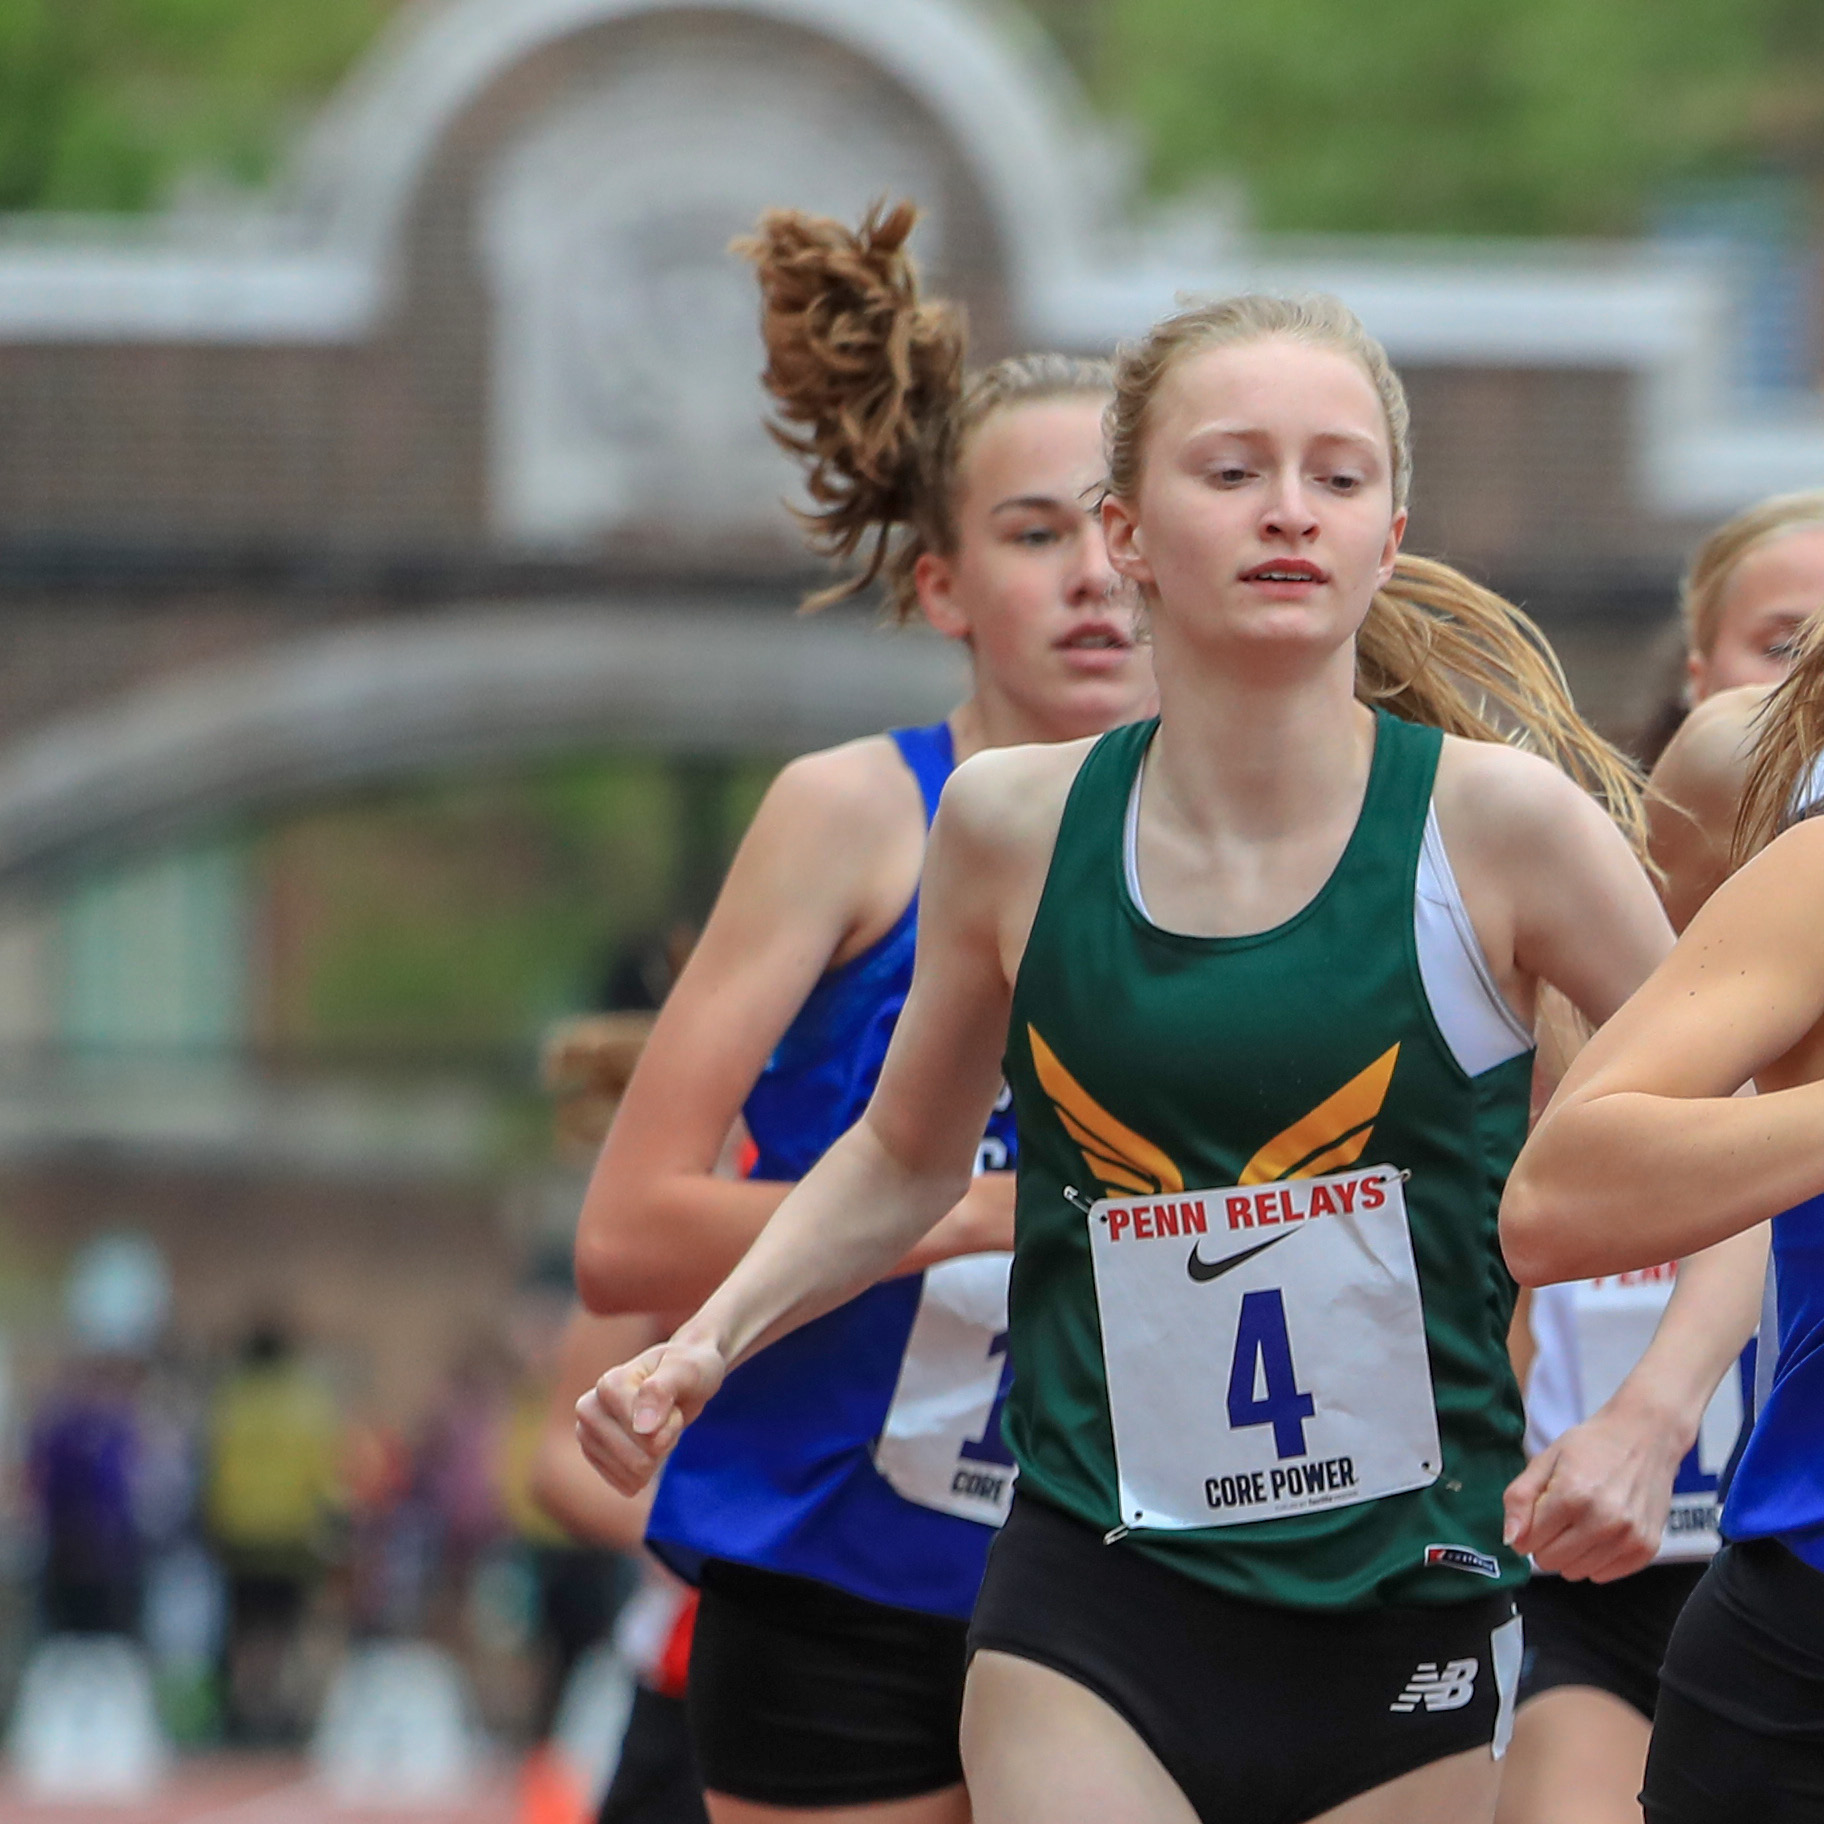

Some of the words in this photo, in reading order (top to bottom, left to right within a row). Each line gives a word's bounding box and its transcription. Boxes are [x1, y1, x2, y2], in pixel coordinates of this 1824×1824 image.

[1106, 1200, 1208, 1242] PENN
[1226, 1175, 1387, 1231] RELAYS
[1227, 1287, 1316, 1461] 4
[1204, 1472, 1268, 1509] CORE
[1270, 1456, 1356, 1500] POWER
